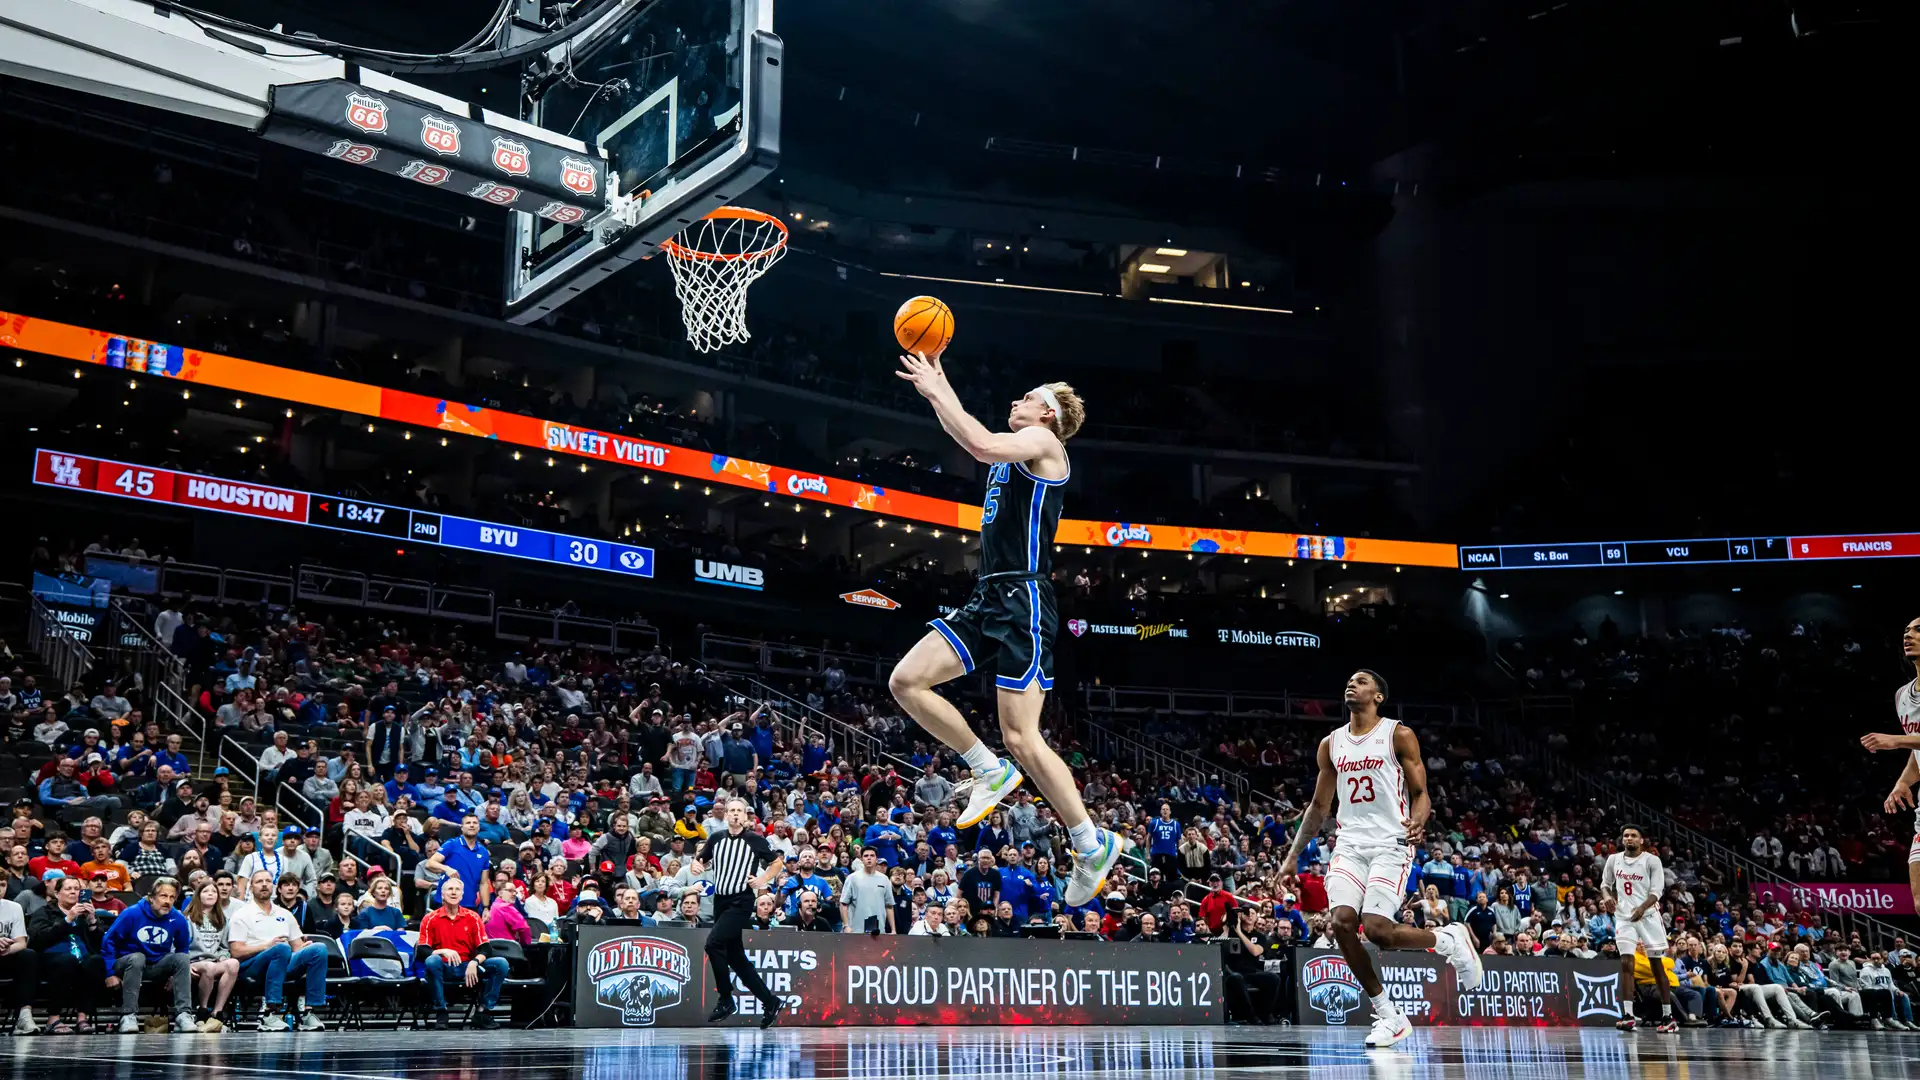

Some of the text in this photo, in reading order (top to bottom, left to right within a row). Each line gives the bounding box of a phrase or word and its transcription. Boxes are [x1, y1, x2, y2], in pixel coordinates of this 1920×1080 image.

[352, 97, 382, 111] PHILLIPS
[353, 108, 379, 125] 66
[427, 119, 455, 134] PHILLIPS
[428, 130, 453, 147] 66
[346, 148, 367, 162] 66
[498, 142, 525, 155] PHILLIPS
[499, 152, 523, 169] 66
[566, 161, 592, 174] PHILLIPS
[418, 167, 441, 182] 66
[567, 172, 589, 188] 66
[488, 188, 510, 202] 66
[556, 207, 577, 221] 66
[547, 426, 609, 454] SWEET
[788, 474, 829, 495] Crush
[982, 486, 1000, 526] 5
[115, 469, 155, 496] 45
[188, 479, 295, 513] HOUSTON
[337, 502, 385, 524] 13:47
[414, 522, 437, 536] 2ND
[479, 526, 518, 547] BYU
[569, 541, 598, 565] 30
[1106, 524, 1152, 546] Crush
[1468, 539, 1892, 563] NCAA St. Bon 59 VCU 76 F 5 FRANCIS
[695, 559, 764, 586] UMB
[852, 594, 888, 607] SERVPRO
[57, 610, 95, 625] Mobile
[1090, 623, 1187, 640] TASTES LIKE Miller TIME
[1231, 630, 1272, 645] Mobile
[1275, 635, 1317, 648] CENTER
[1337, 755, 1384, 773] Houston
[1347, 776, 1376, 804] 23
[1161, 830, 1170, 840] 15
[1616, 869, 1644, 882] Houston
[1624, 881, 1633, 896] 8
[1817, 888, 1894, 909] Mobile
[588, 940, 690, 979] OLD TRAPPER
[744, 949, 818, 970] HAT'S
[1304, 959, 1361, 988] OLD TRAPPE
[1381, 966, 1437, 983] WHAT'S
[847, 965, 1212, 1007] PROUD PARTNER OF THE BIG 12
[1383, 983, 1424, 999] YOUR
[1504, 971, 1560, 994] PARTNER
[1394, 1000, 1431, 1016] EEF?
[1458, 994, 1544, 1018] OF THE BIG 12
